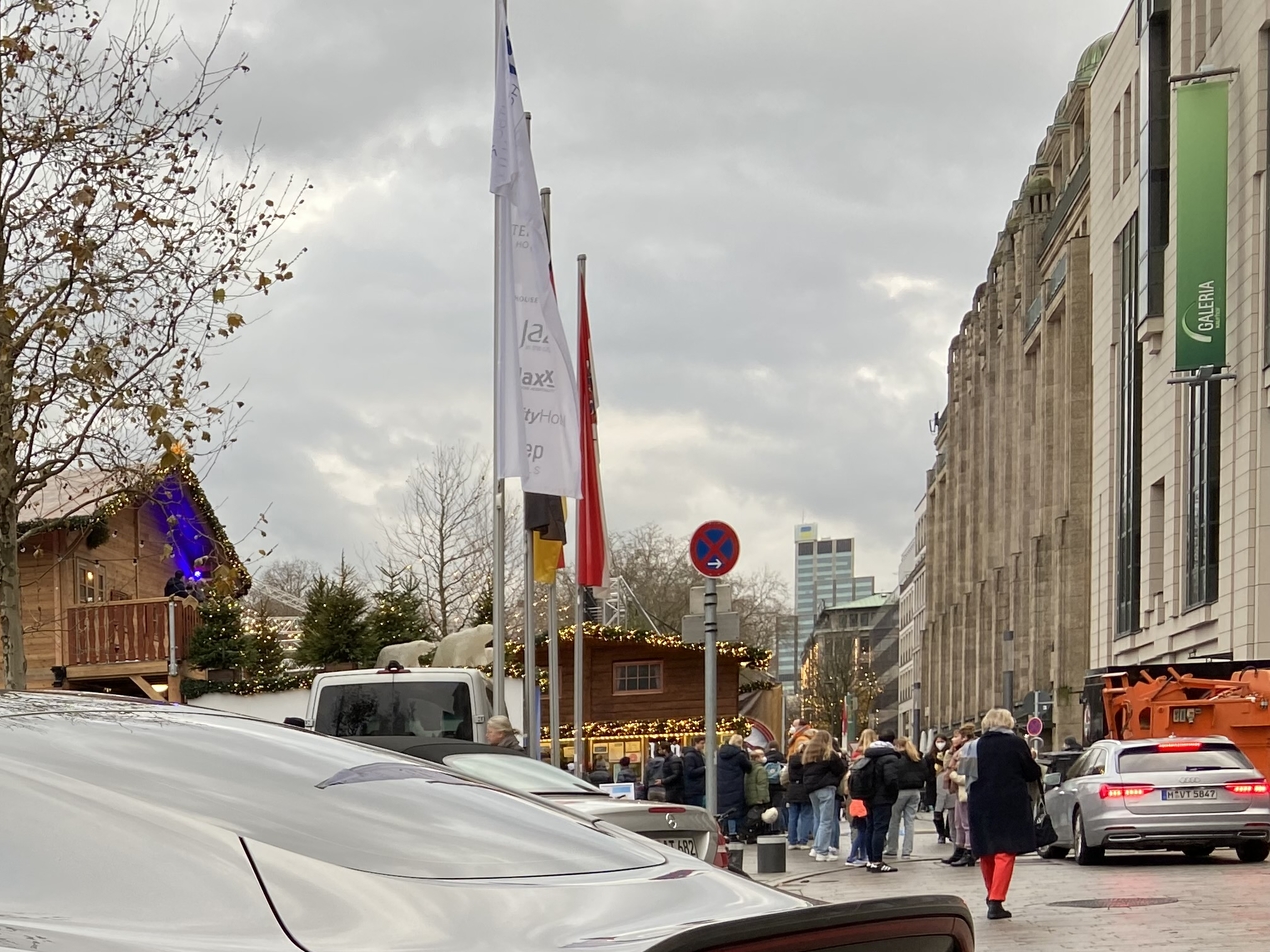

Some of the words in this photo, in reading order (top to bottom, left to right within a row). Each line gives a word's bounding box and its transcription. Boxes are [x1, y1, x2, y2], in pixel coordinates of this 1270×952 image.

[1198, 280, 1214, 331] GALERIA
[1180, 791, 1191, 799] VT
[1194, 790, 1216, 798] 5847
